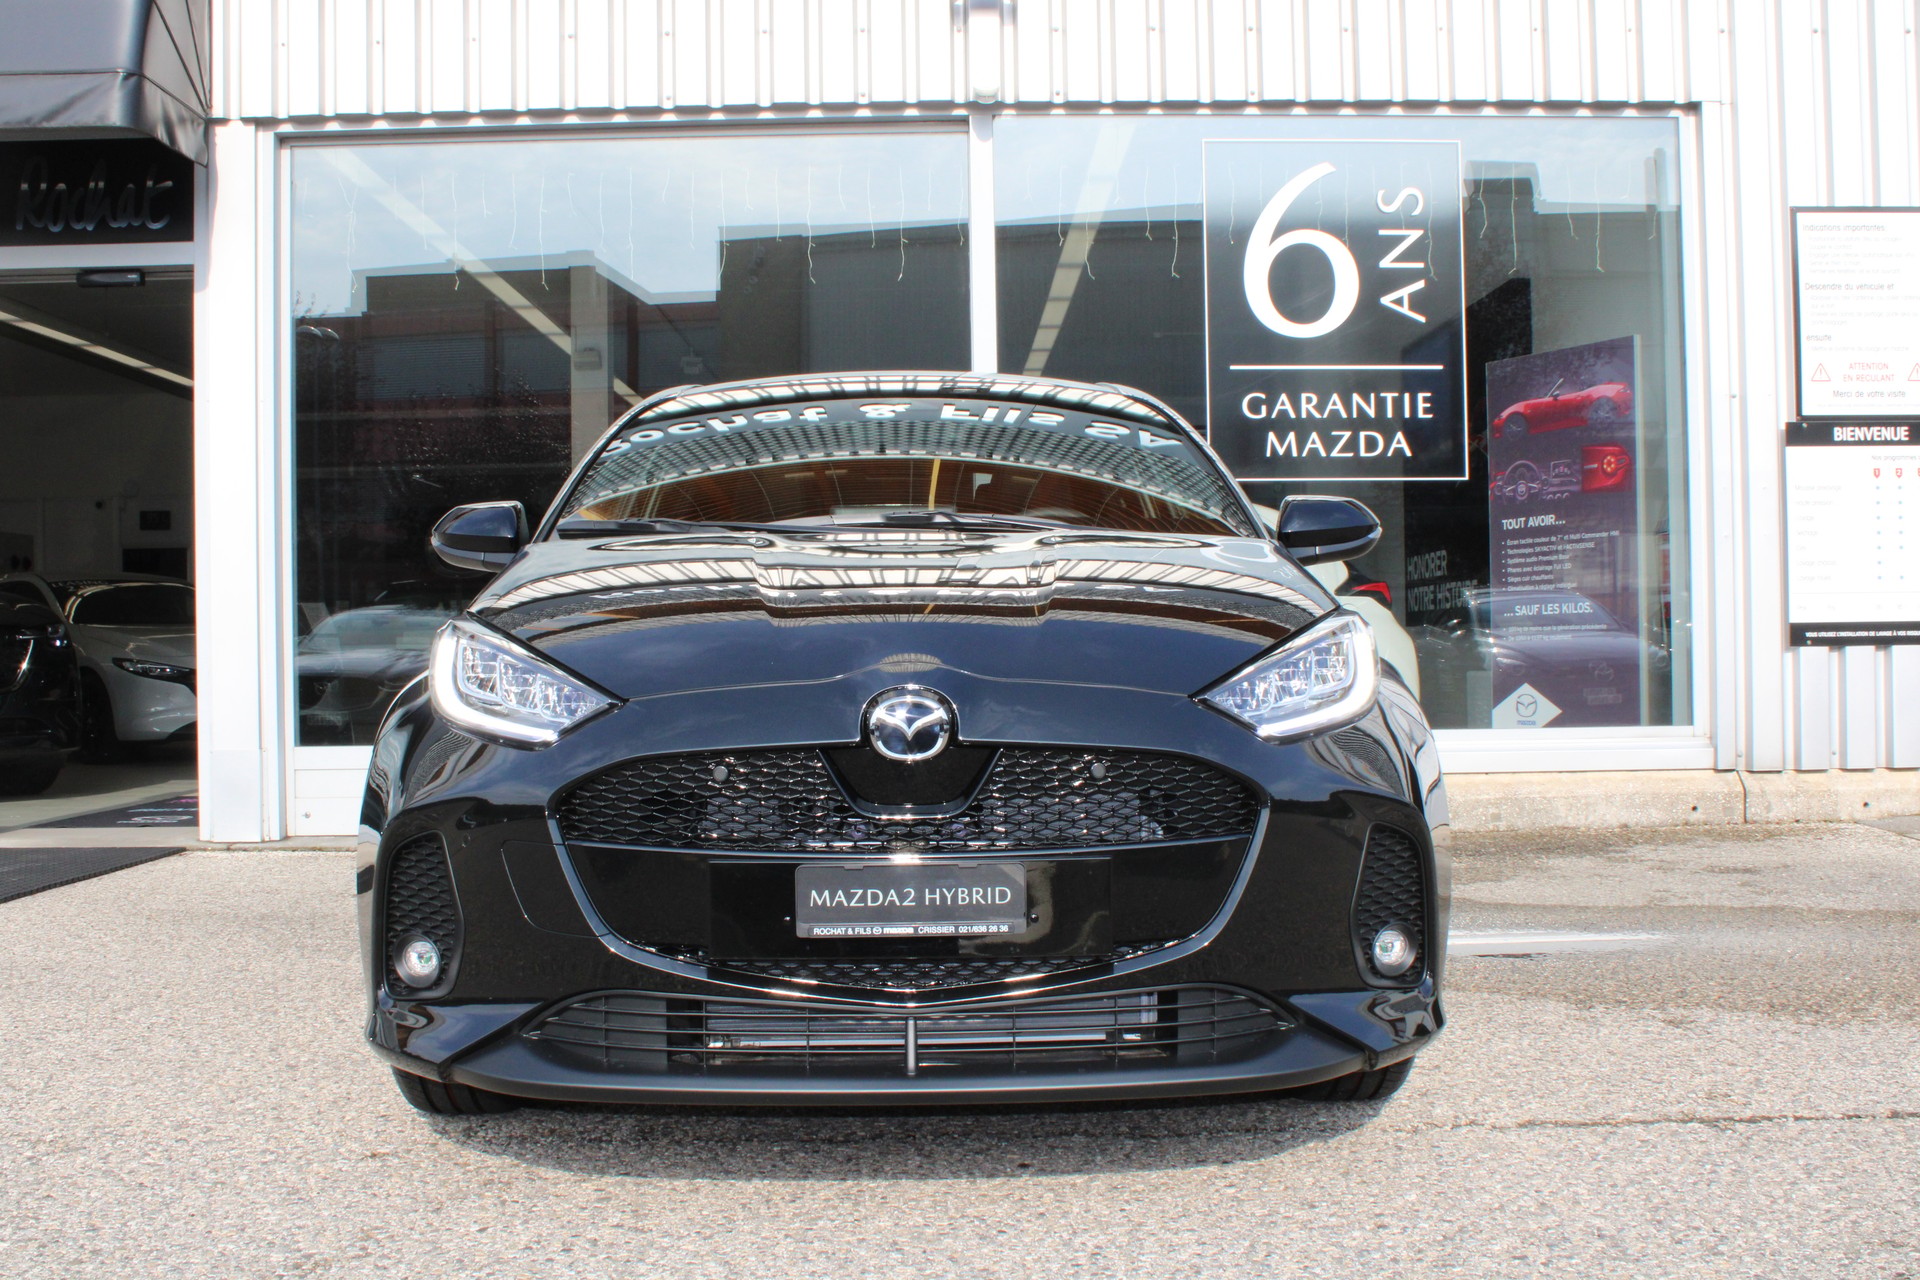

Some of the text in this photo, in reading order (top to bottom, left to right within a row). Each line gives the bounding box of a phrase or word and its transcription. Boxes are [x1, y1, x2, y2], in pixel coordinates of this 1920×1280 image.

[15, 155, 174, 232] Rochat
[1802, 223, 1841, 232] Indications
[1243, 161, 1360, 339] 6
[1376, 186, 1427, 323] ANS
[1804, 282, 1842, 291] Descendre
[1806, 334, 1832, 342] ensuite
[1848, 362, 1889, 371] ATTENTION
[1843, 374, 1853, 382] EN
[1832, 390, 1906, 398] Merci de votre visite
[1241, 391, 1434, 420] GARANTIE
[1832, 426, 1910, 442] BIENVENUE
[1266, 430, 1413, 458] MAZDA
[1502, 516, 1525, 531] TOUT
[1407, 549, 1448, 581] HONORER
[1408, 584, 1435, 613] NOTRE
[1542, 603, 1560, 615] LES
[1562, 602, 1593, 614] KILOS.
[809, 886, 1012, 907] MAZDA2 HYBRID
[813, 927, 846, 936] ROCHAT
[854, 927, 872, 935] FILS
[883, 926, 914, 934] mazda
[918, 926, 955, 934] CRISSIER
[958, 924, 987, 934] 021/636
[988, 924, 998, 932] 26
[998, 924, 1008, 932] 36
